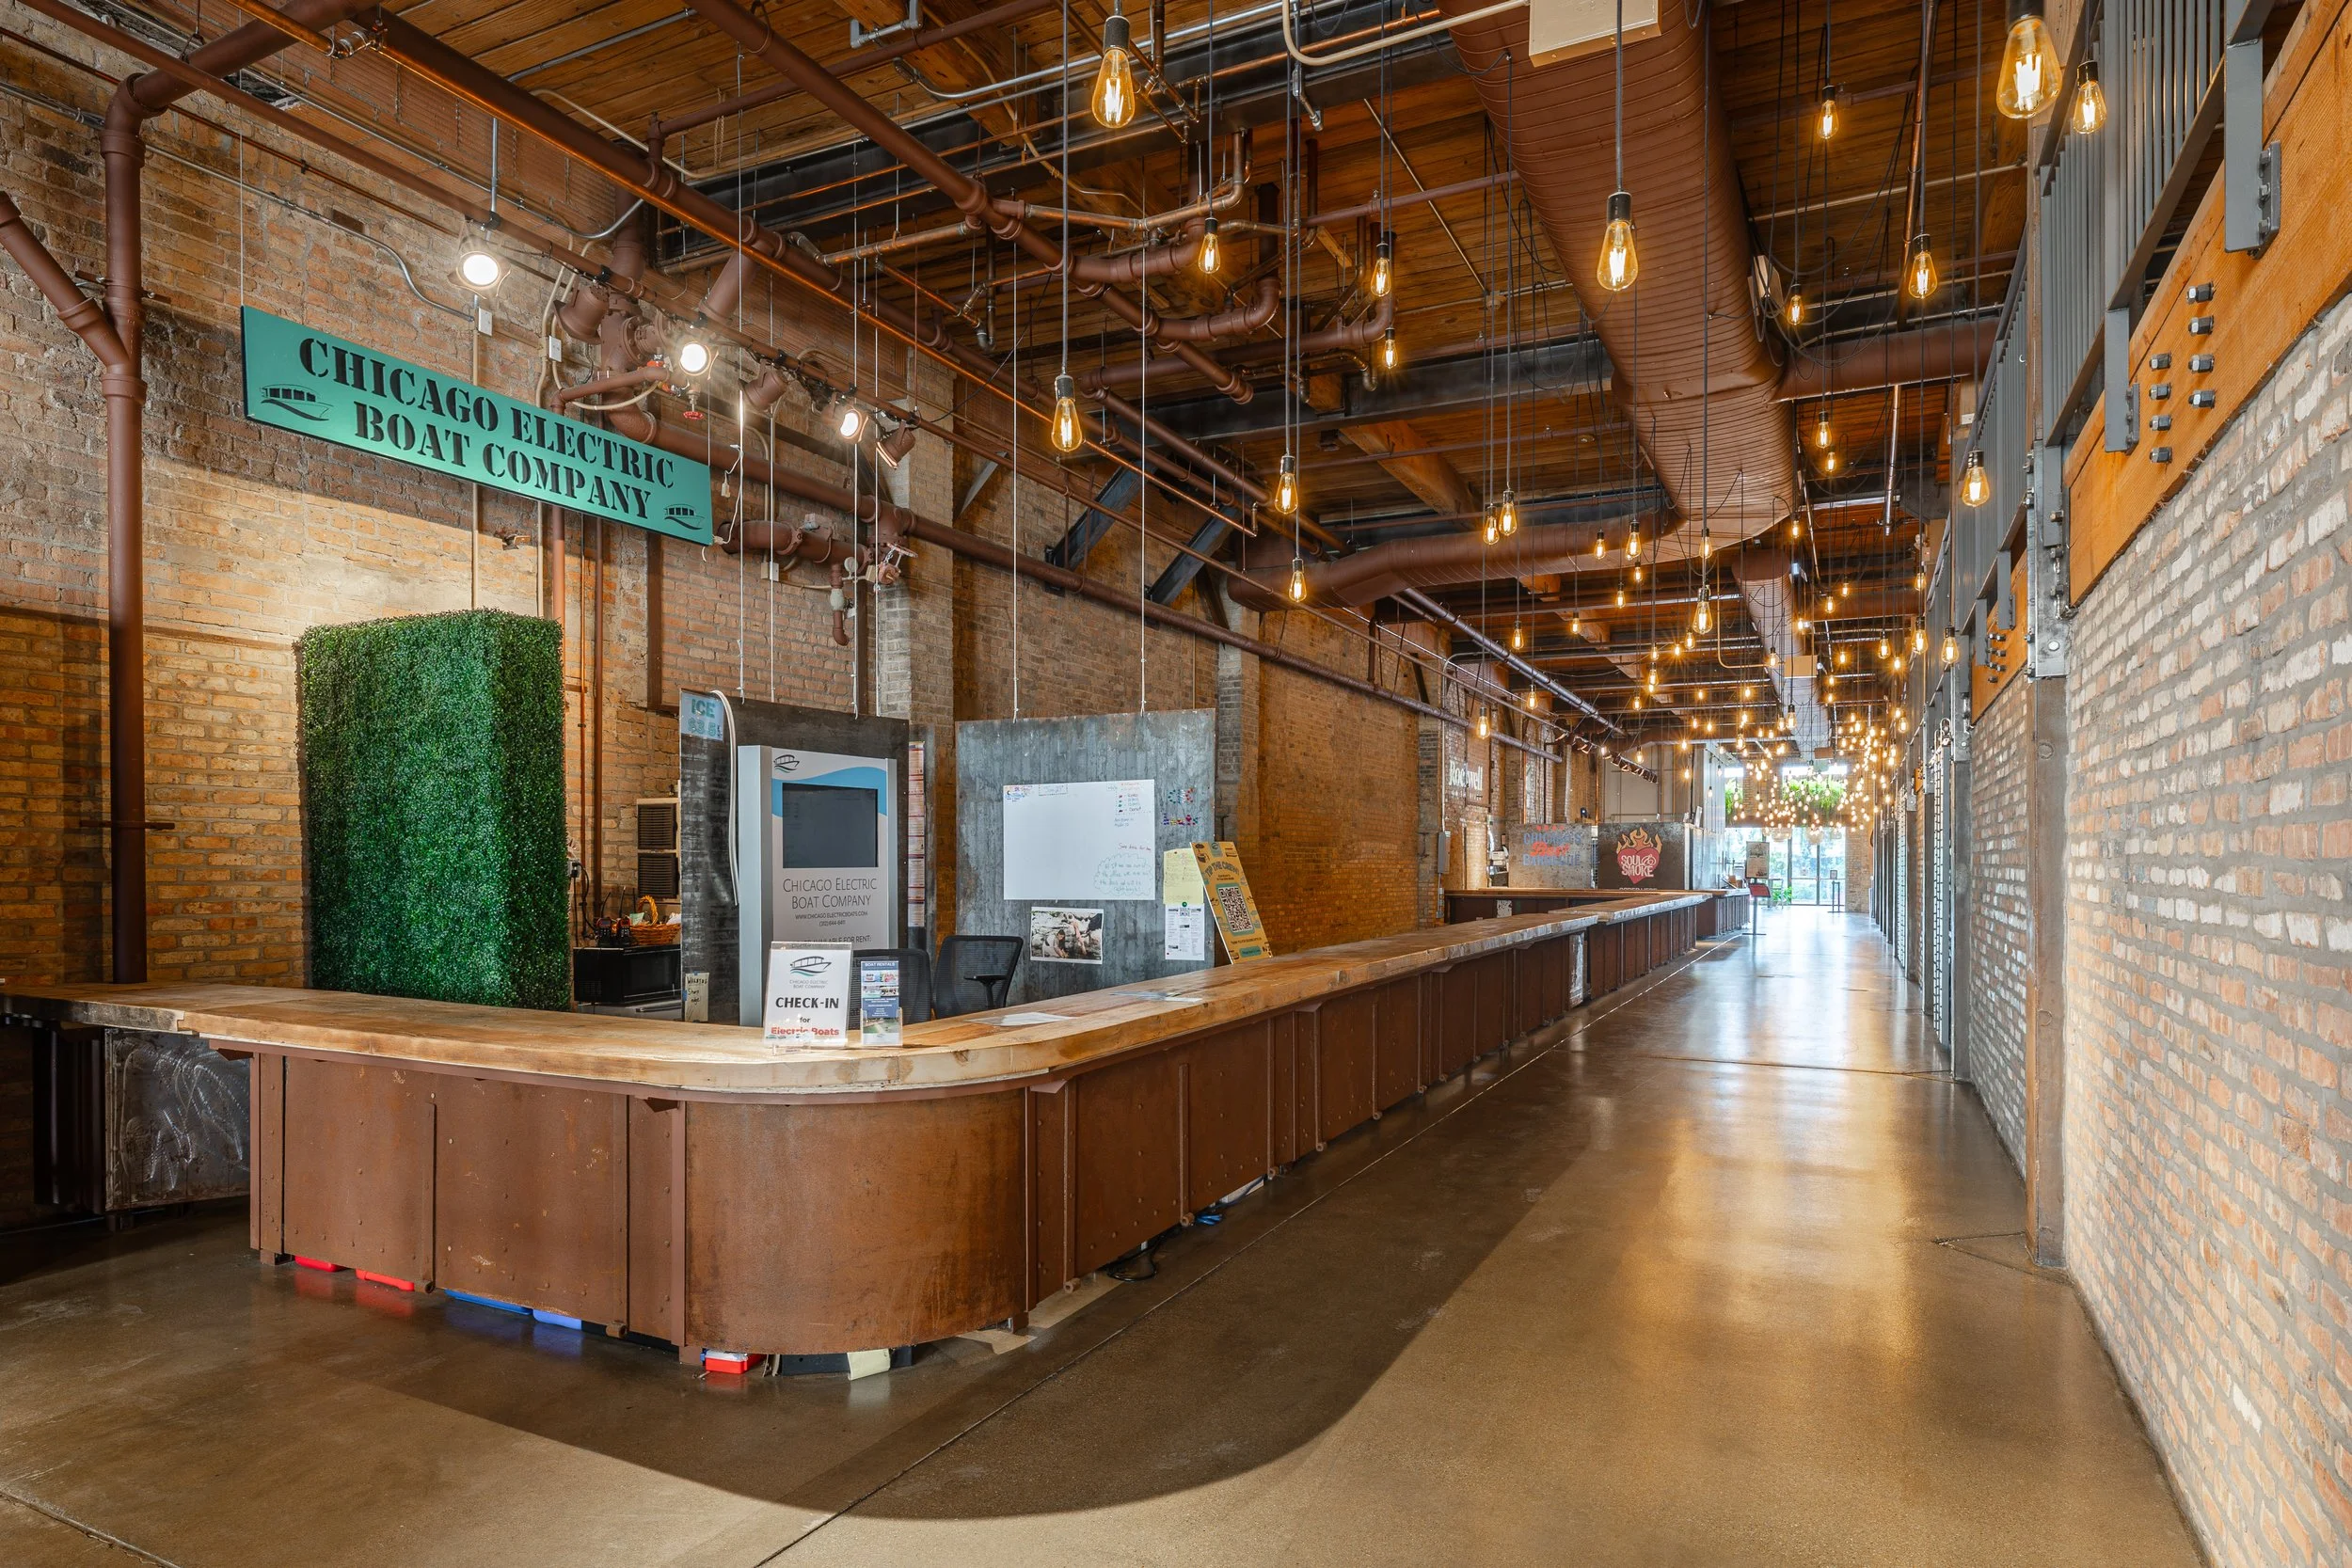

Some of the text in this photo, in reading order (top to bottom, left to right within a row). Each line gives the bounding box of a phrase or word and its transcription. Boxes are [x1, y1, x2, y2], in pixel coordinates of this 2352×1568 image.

[298, 337, 675, 490] CHICAGO ELECTRIC
[354, 400, 652, 520] BOAT COMPANY
[691, 698, 715, 719] ICE
[1620, 855, 1643, 865] SOUL
[1621, 864, 1654, 878] SMOKE
[783, 877, 877, 893] CHICAGO ELECTRIC
[791, 894, 871, 910] BOAT COMPANY
[775, 997, 839, 1008] CHECK-IN
